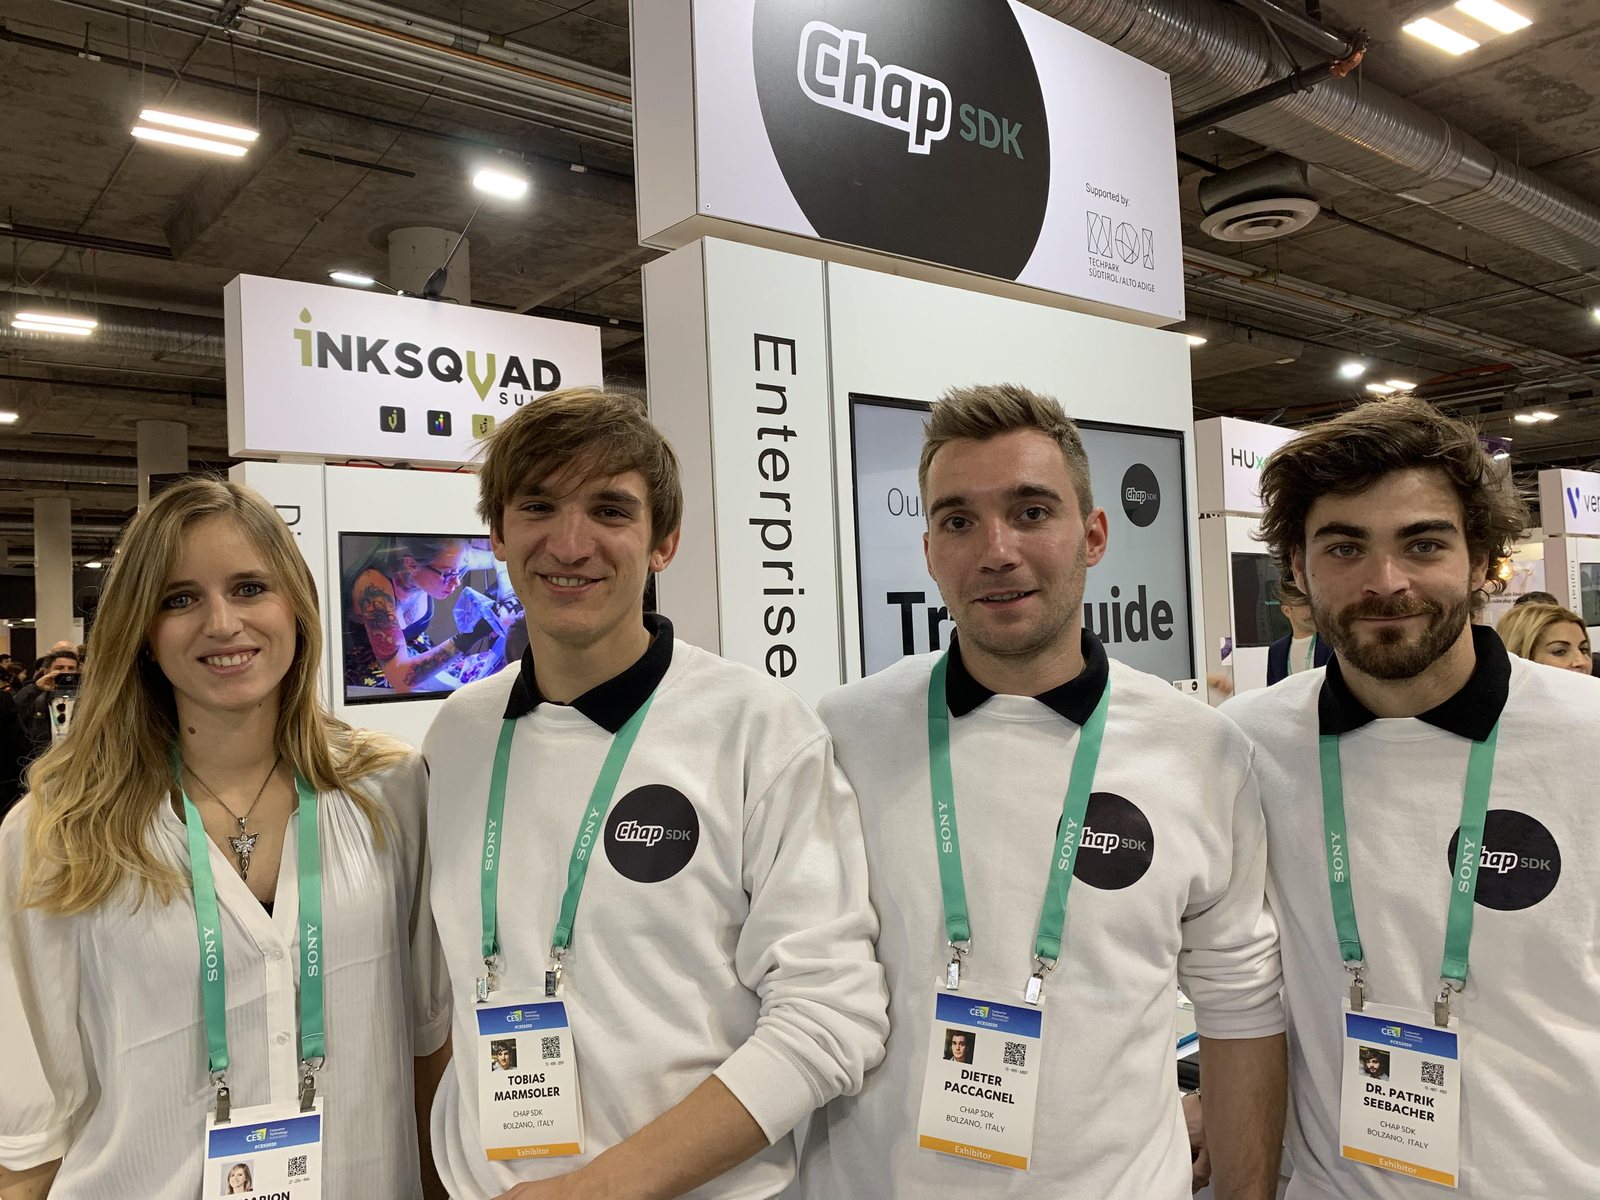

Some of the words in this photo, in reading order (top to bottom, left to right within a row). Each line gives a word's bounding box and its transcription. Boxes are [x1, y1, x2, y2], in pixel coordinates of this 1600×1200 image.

[797, 20, 952, 155] Chap
[959, 103, 1024, 159] SDK
[1085, 183, 1119, 202] Supported
[1088, 257, 1120, 272] TECHPARK
[1088, 267, 1118, 283] SÜDTIROL
[1137, 281, 1155, 292] ADIGE
[1231, 448, 1268, 470] HUx
[749, 333, 805, 678] Enterprise
[1125, 487, 1147, 505] Chap
[886, 591, 954, 655] Tr
[1083, 584, 1174, 643] uide
[576, 806, 600, 862] SONY
[615, 820, 665, 847] Chap
[665, 829, 692, 841] SDK
[937, 800, 953, 853] SONY
[484, 818, 497, 871] SONY
[1058, 817, 1078, 871] SONY
[1079, 826, 1120, 854] hap
[1121, 838, 1146, 852] SDK
[1330, 831, 1344, 883] SONY
[1458, 837, 1476, 894] SONY
[1479, 845, 1518, 874] hap
[1520, 857, 1551, 871] SDK
[203, 926, 219, 982] SONY
[307, 922, 319, 977] SONY
[506, 1015, 520, 1023] CES
[970, 1008, 985, 1017] CES
[1381, 1027, 1397, 1037] CES
[507, 1072, 546, 1086] TOBIAS
[961, 1069, 1002, 1087] DIETER
[494, 1086, 560, 1102] MARMSOLER
[944, 1081, 1015, 1104] PACCAGNEL
[1365, 1082, 1386, 1096] DR.
[1389, 1088, 1435, 1108] PATRIK
[512, 1109, 530, 1118] CHAP
[530, 1109, 543, 1117] SDK
[959, 1105, 980, 1115] CHAP
[980, 1109, 995, 1119] SDK
[1363, 1096, 1435, 1122] SEEBACHER
[503, 1121, 535, 1130] BOLZANO,
[537, 1119, 555, 1128] ITALY
[946, 1114, 982, 1129] BOLZANO,
[985, 1122, 1006, 1133] ITALY
[1379, 1120, 1401, 1130] CHAP
[1401, 1125, 1416, 1135] SDK
[246, 1133, 262, 1143] CES
[1367, 1127, 1405, 1144] BOLZANO,
[1407, 1138, 1429, 1150] ITALY
[517, 1147, 550, 1157] Exhibitor
[954, 1145, 992, 1160] Exhibitor
[1379, 1158, 1417, 1175] Exhibitor
